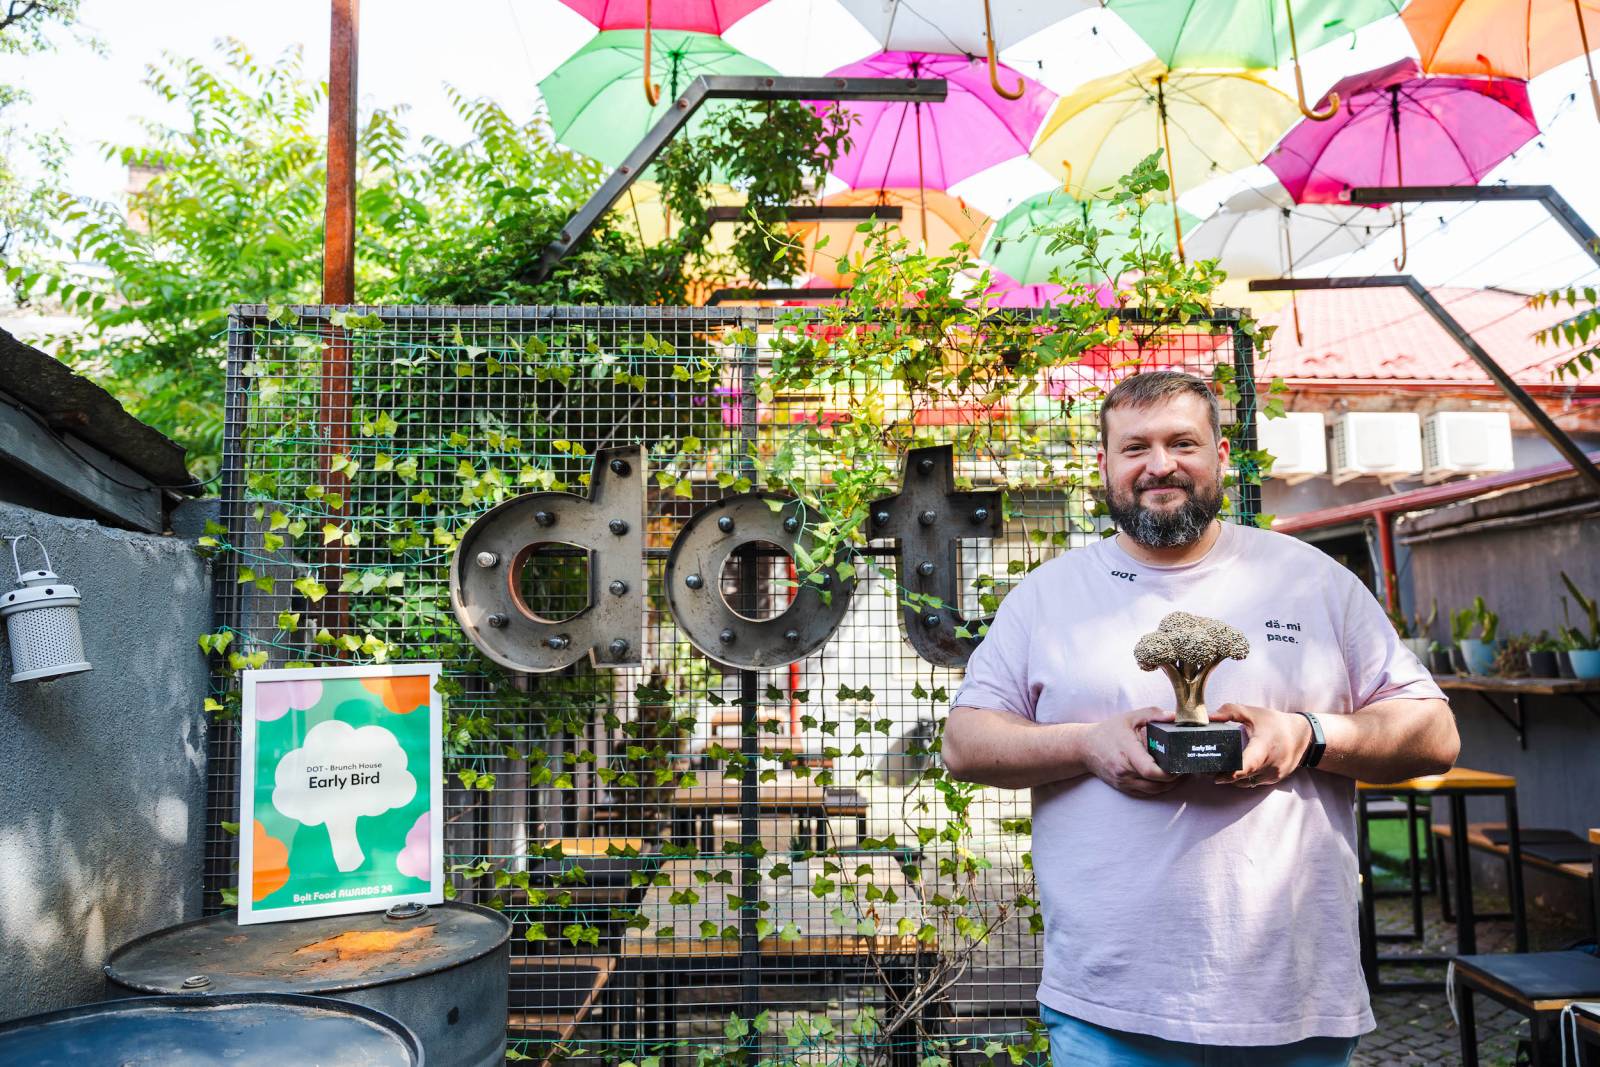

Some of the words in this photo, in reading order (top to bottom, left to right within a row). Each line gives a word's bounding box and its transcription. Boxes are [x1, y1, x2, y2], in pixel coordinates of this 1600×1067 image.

[451, 443, 1003, 674] dot
[1265, 619, 1301, 631] dă-mi
[1266, 633, 1299, 644] pace.
[306, 765, 325, 773] DOT
[330, 764, 357, 772] Brunch
[309, 774, 348, 790] Early
[351, 771, 380, 786] Bird
[293, 892, 311, 904] Bolt
[313, 890, 337, 901] Food
[338, 887, 379, 898] AWARDS
[380, 884, 393, 894] 24
